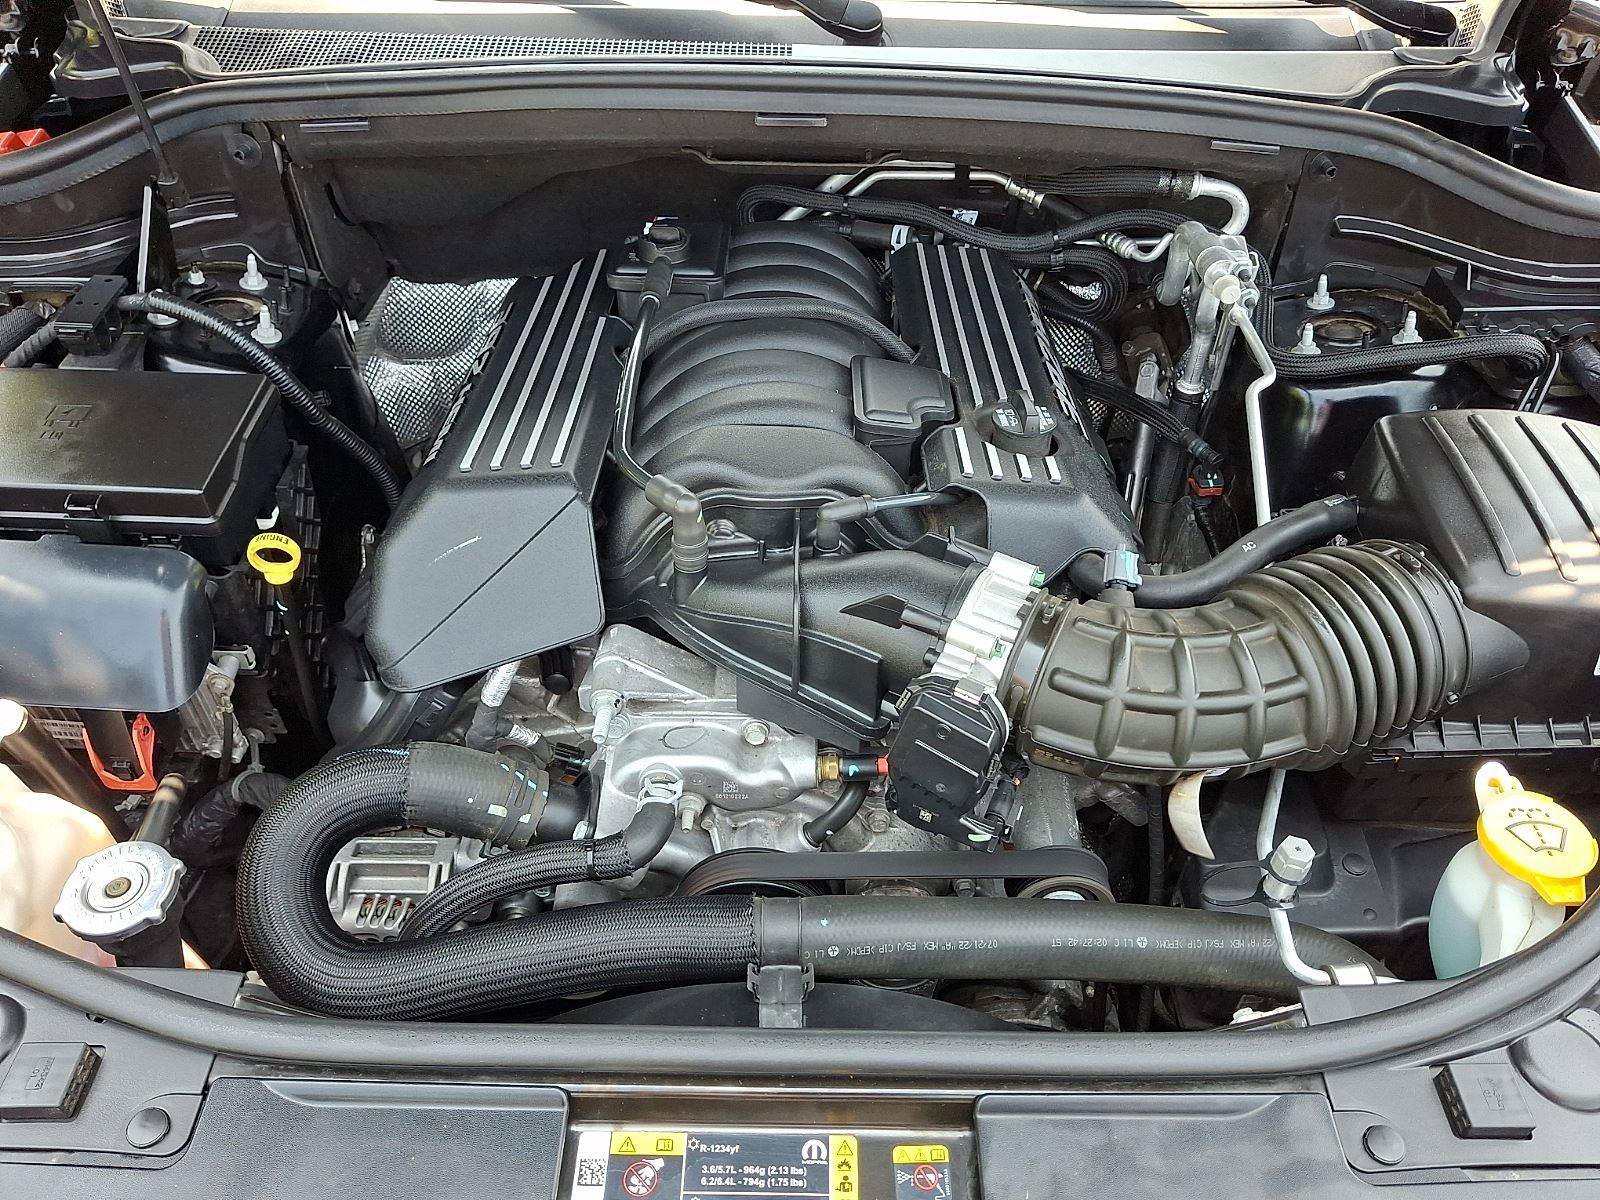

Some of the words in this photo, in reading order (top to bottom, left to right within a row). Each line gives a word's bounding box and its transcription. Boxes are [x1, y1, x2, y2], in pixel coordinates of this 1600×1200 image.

[254, 534, 290, 545] ENGINE
[1241, 541, 1257, 553] AC
[924, 941, 938, 951] MEX
[1051, 938, 1062, 948] ST
[1068, 938, 1108, 948] 02:27:42
[700, 1144, 740, 1155] R-1234yf
[701, 1165, 737, 1174] 3.6/5.7L
[743, 1165, 766, 1176] 964g
[767, 1165, 789, 1176] (2.13
[790, 1165, 807, 1176] lbs)
[700, 1176, 737, 1186] 6.2/6.4L
[742, 1177, 765, 1188] 794g
[767, 1177, 789, 1188] (1.75
[790, 1177, 807, 1188] lbs)
